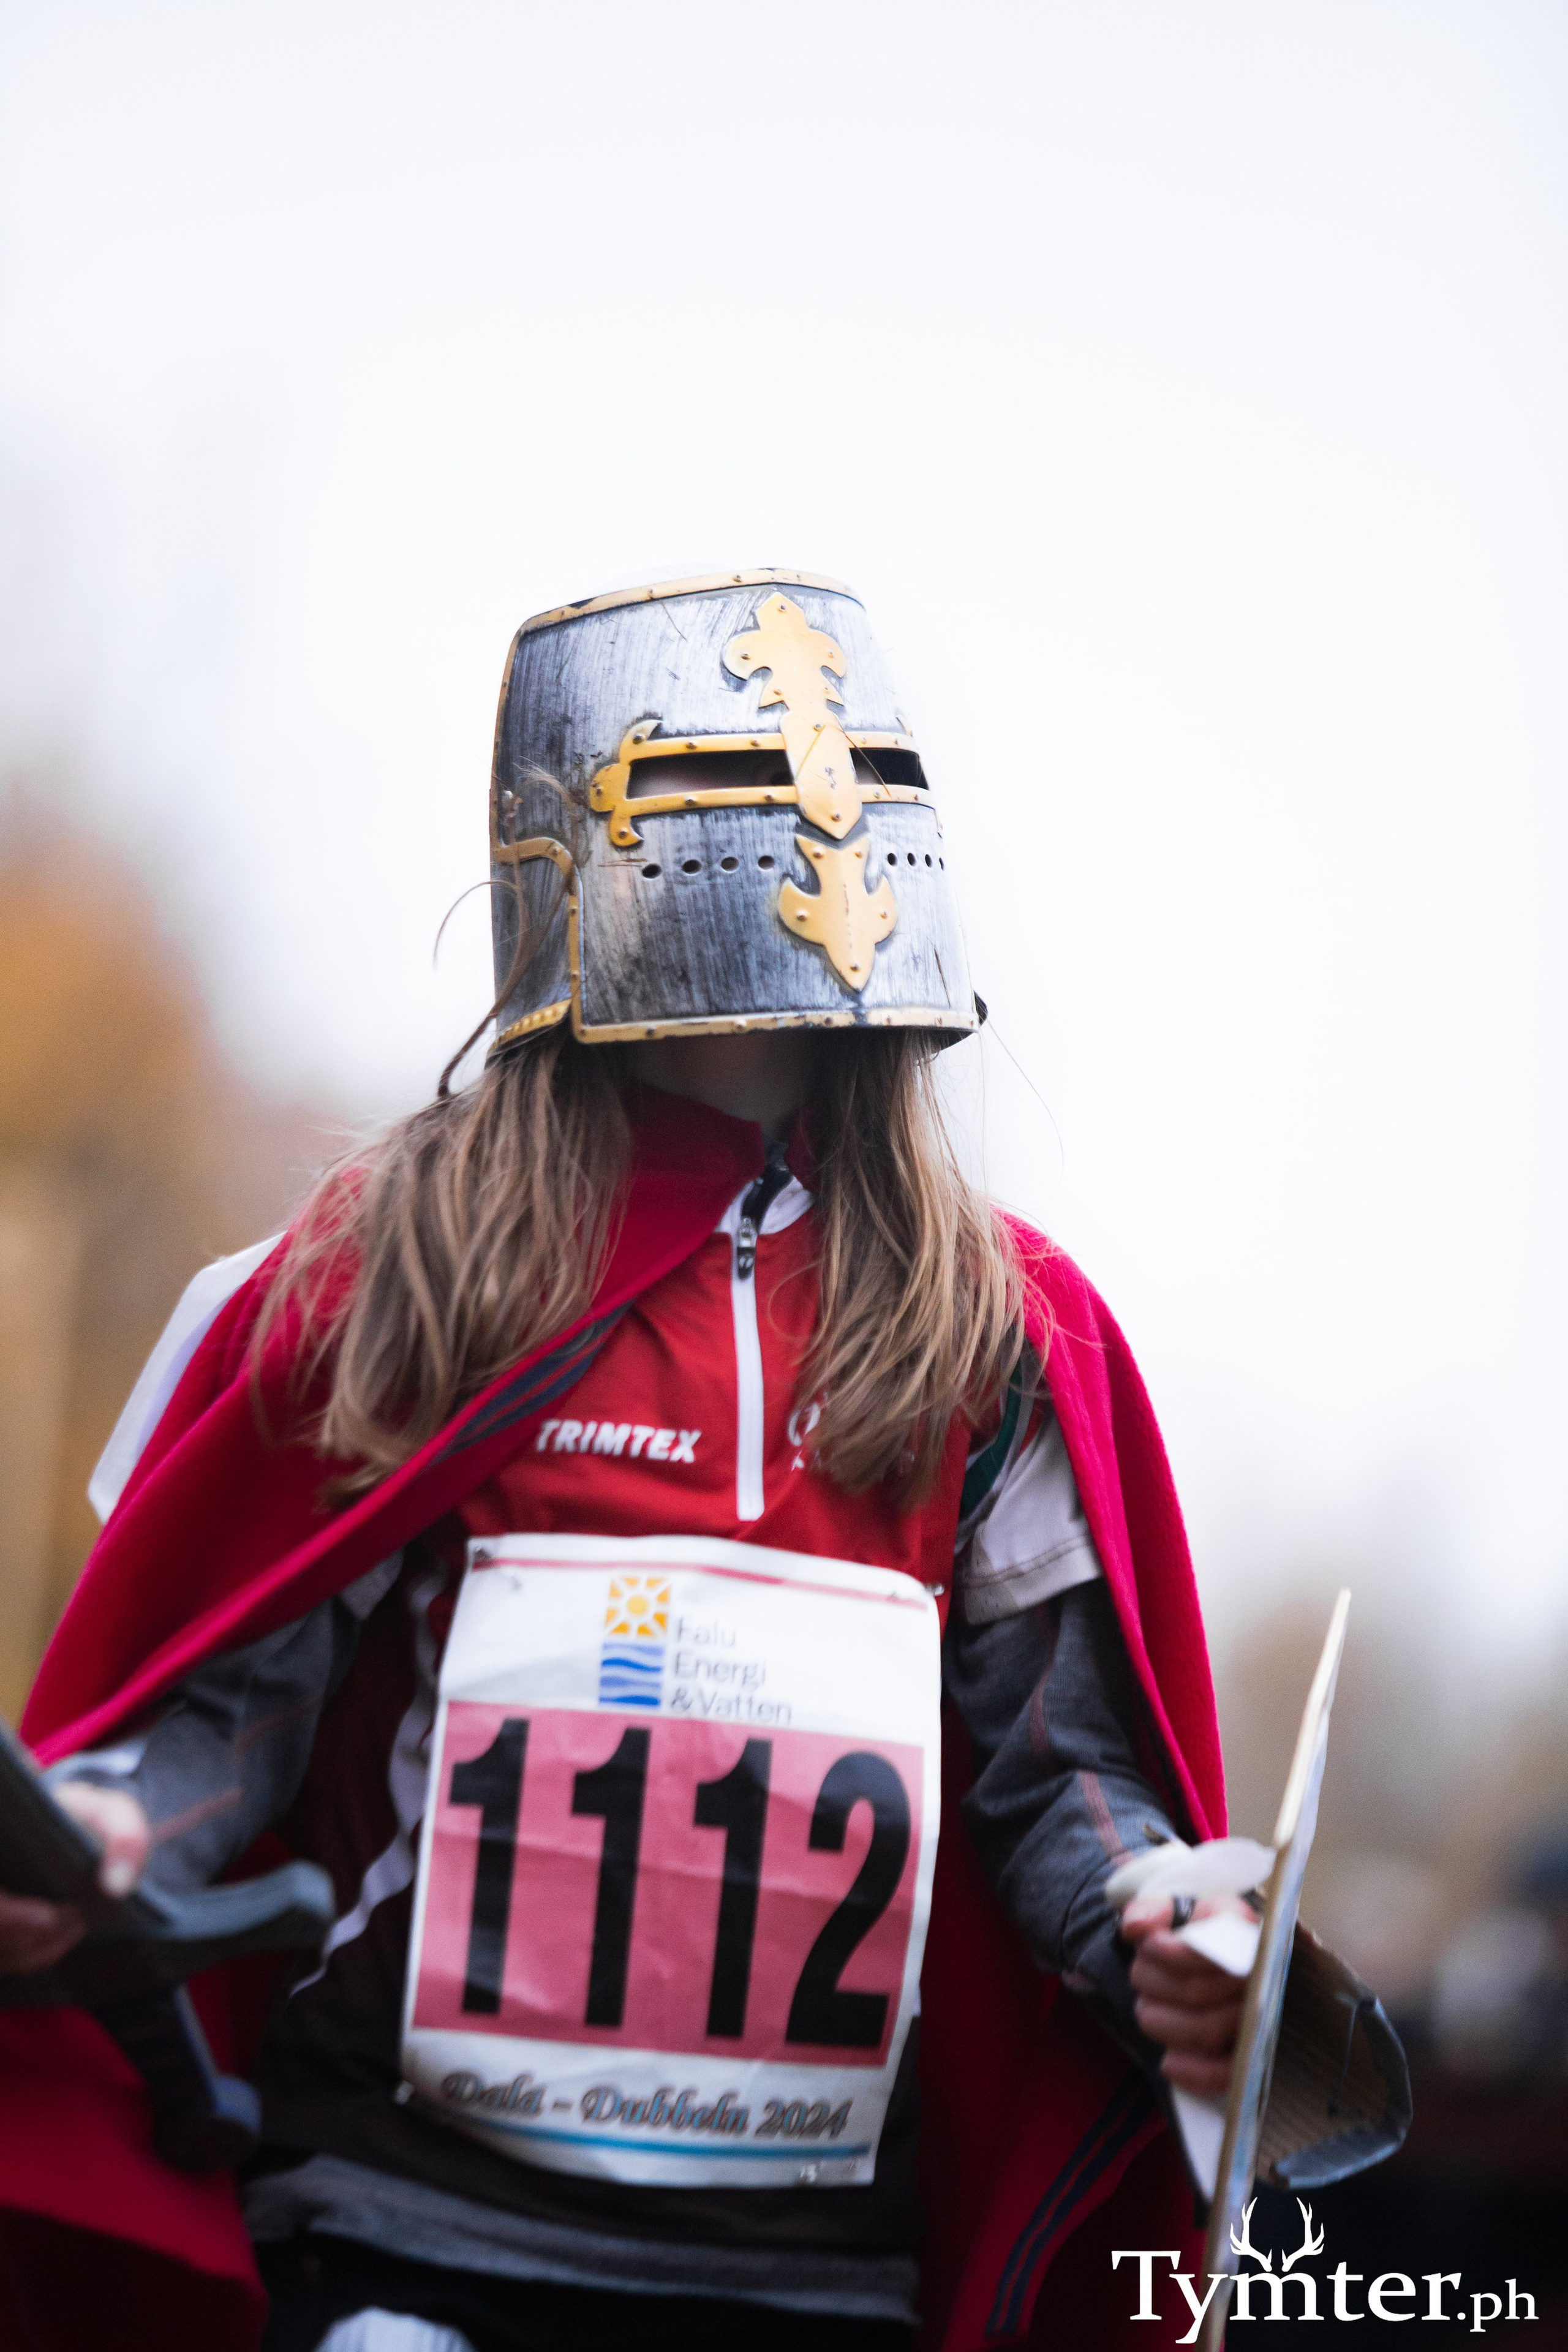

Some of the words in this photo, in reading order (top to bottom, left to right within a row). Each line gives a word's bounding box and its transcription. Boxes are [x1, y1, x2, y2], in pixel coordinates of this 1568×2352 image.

[537, 1419, 701, 1463] TRIMTEX
[676, 1617, 736, 1648] Falu
[674, 1653, 767, 1689] Energi
[448, 1718, 911, 2048] 1112
[441, 2070, 546, 2114] Dala
[754, 2100, 853, 2138] 2024
